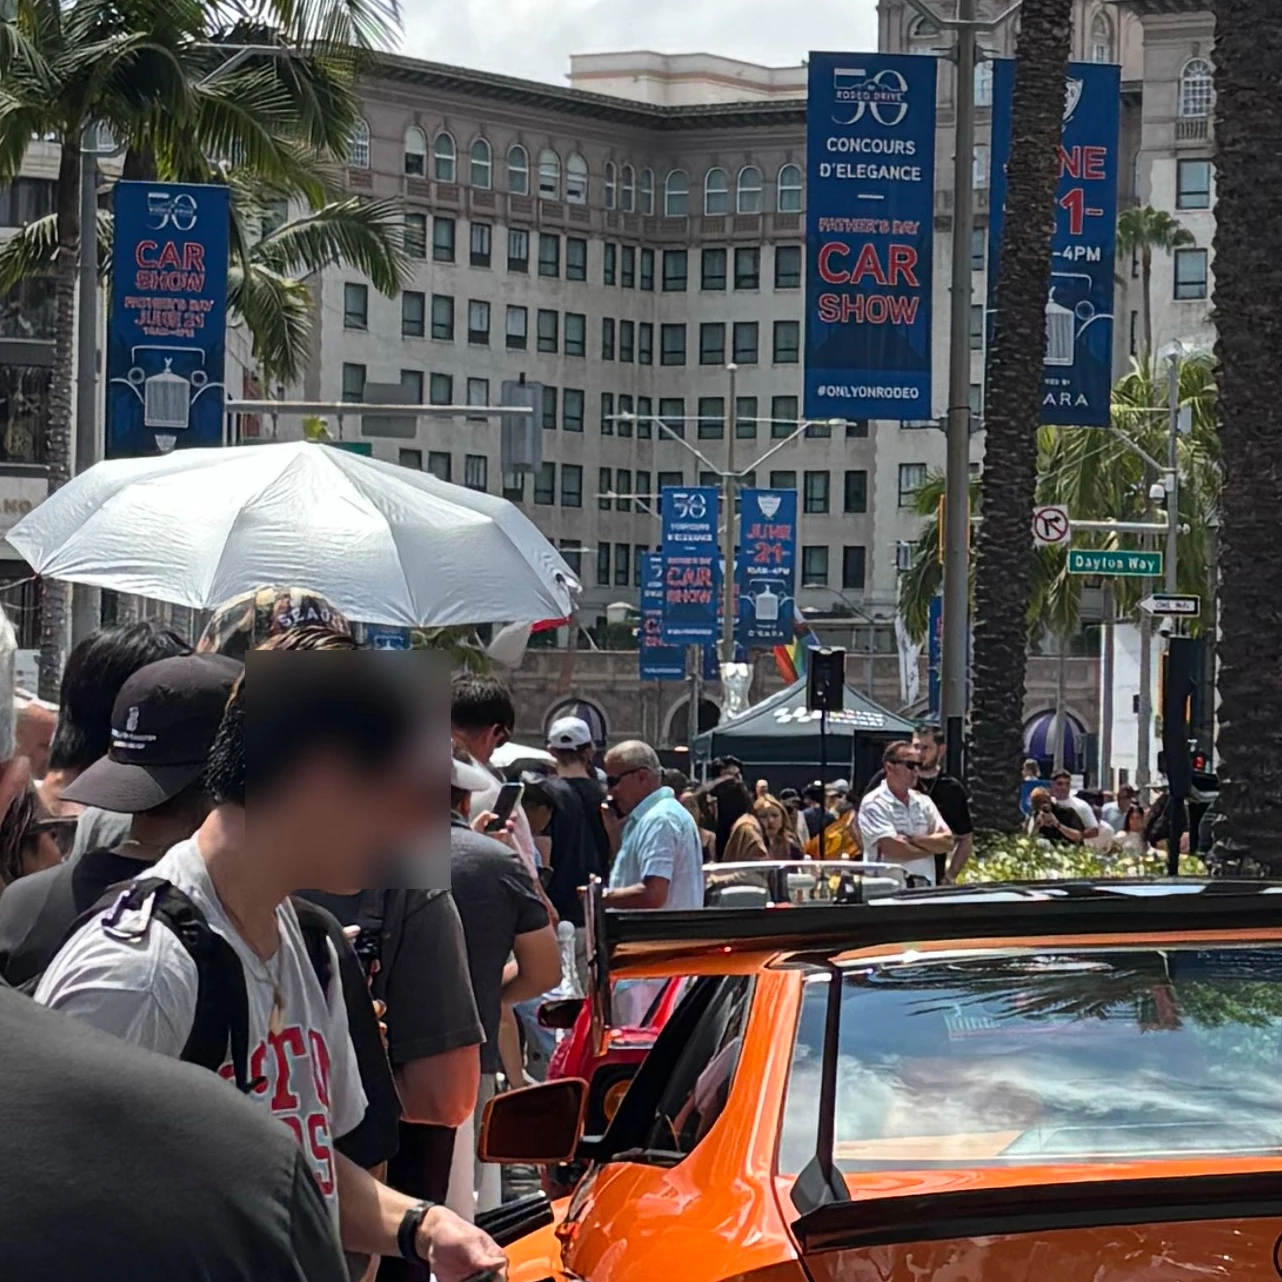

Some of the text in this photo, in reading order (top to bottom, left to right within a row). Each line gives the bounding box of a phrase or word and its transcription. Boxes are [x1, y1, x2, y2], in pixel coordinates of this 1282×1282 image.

[831, 67, 908, 126] 50
[836, 90, 905, 102] RODEO DRIVE
[826, 137, 916, 155] CONCOURS
[820, 163, 922, 181] D'ELEGANCE
[1055, 145, 1107, 179] NE
[135, 239, 205, 272] CAR
[818, 241, 920, 287] CAR
[135, 269, 206, 292] SHOW
[817, 292, 919, 325] SHOW
[817, 384, 919, 400] #ONLYONRODEO
[1042, 391, 1089, 407] ARA
[1075, 554, 1155, 572] Dayton Way
[666, 566, 712, 588] CAR
